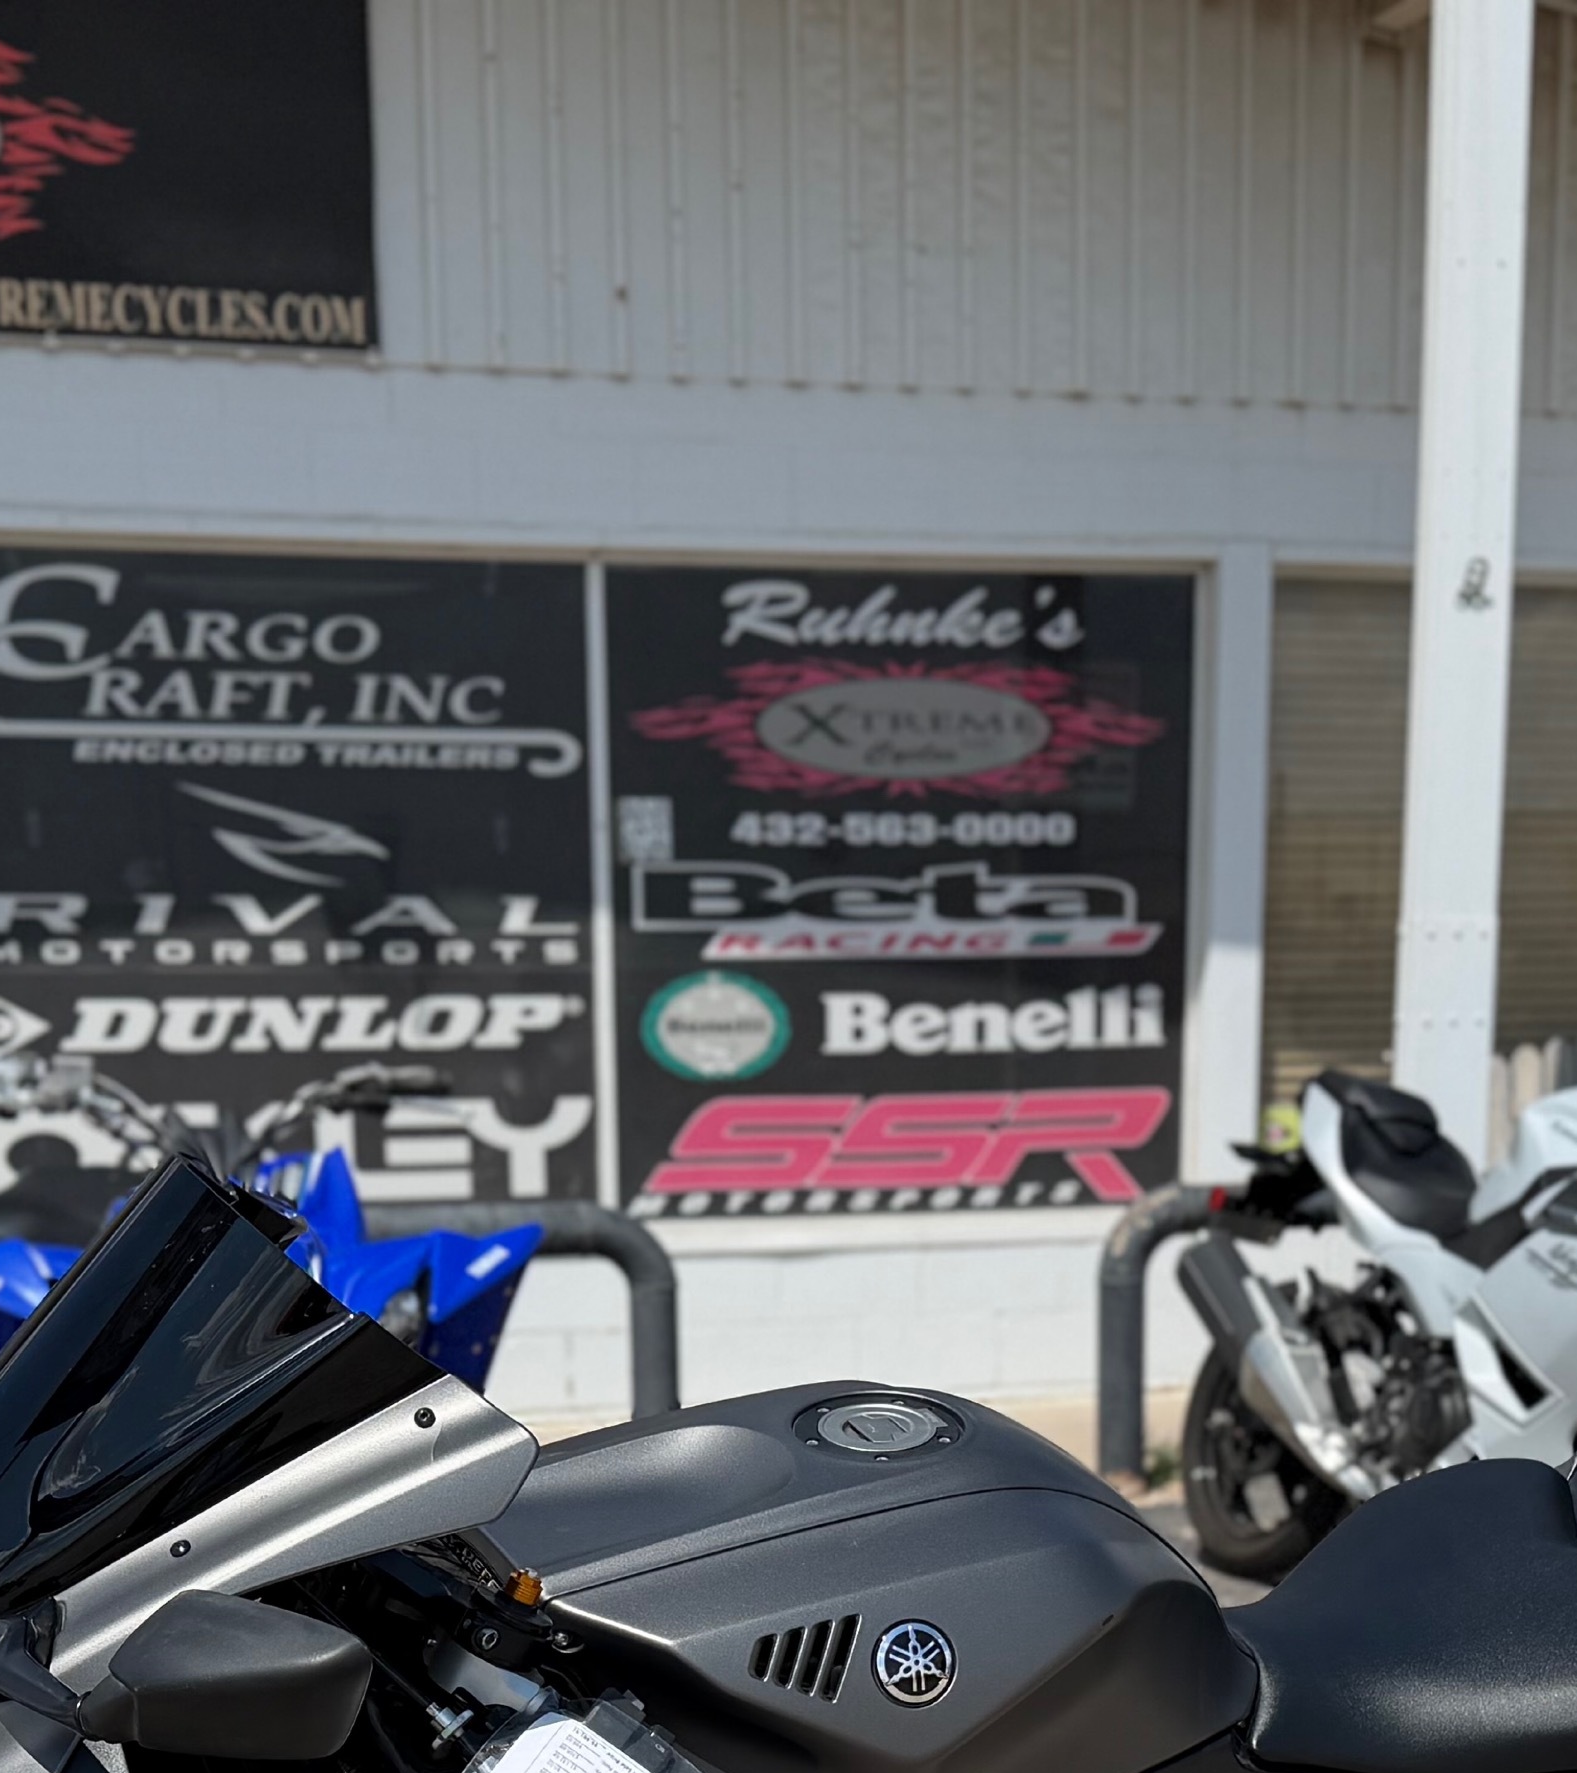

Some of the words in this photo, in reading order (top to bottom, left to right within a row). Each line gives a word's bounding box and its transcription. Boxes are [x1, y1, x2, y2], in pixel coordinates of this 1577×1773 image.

[721, 580, 1086, 649] Ruhnke's
[348, 673, 507, 725] INC
[788, 703, 1042, 747] XTREME
[74, 738, 305, 766] ENCLOSED
[319, 743, 520, 771] TRAILERS
[730, 811, 1077, 846] 432-563-0000
[717, 931, 1017, 954] RACING
[59, 995, 566, 1053] DUNLOP
[820, 983, 1168, 1056] Benelli
[643, 1086, 1173, 1202] SSR
